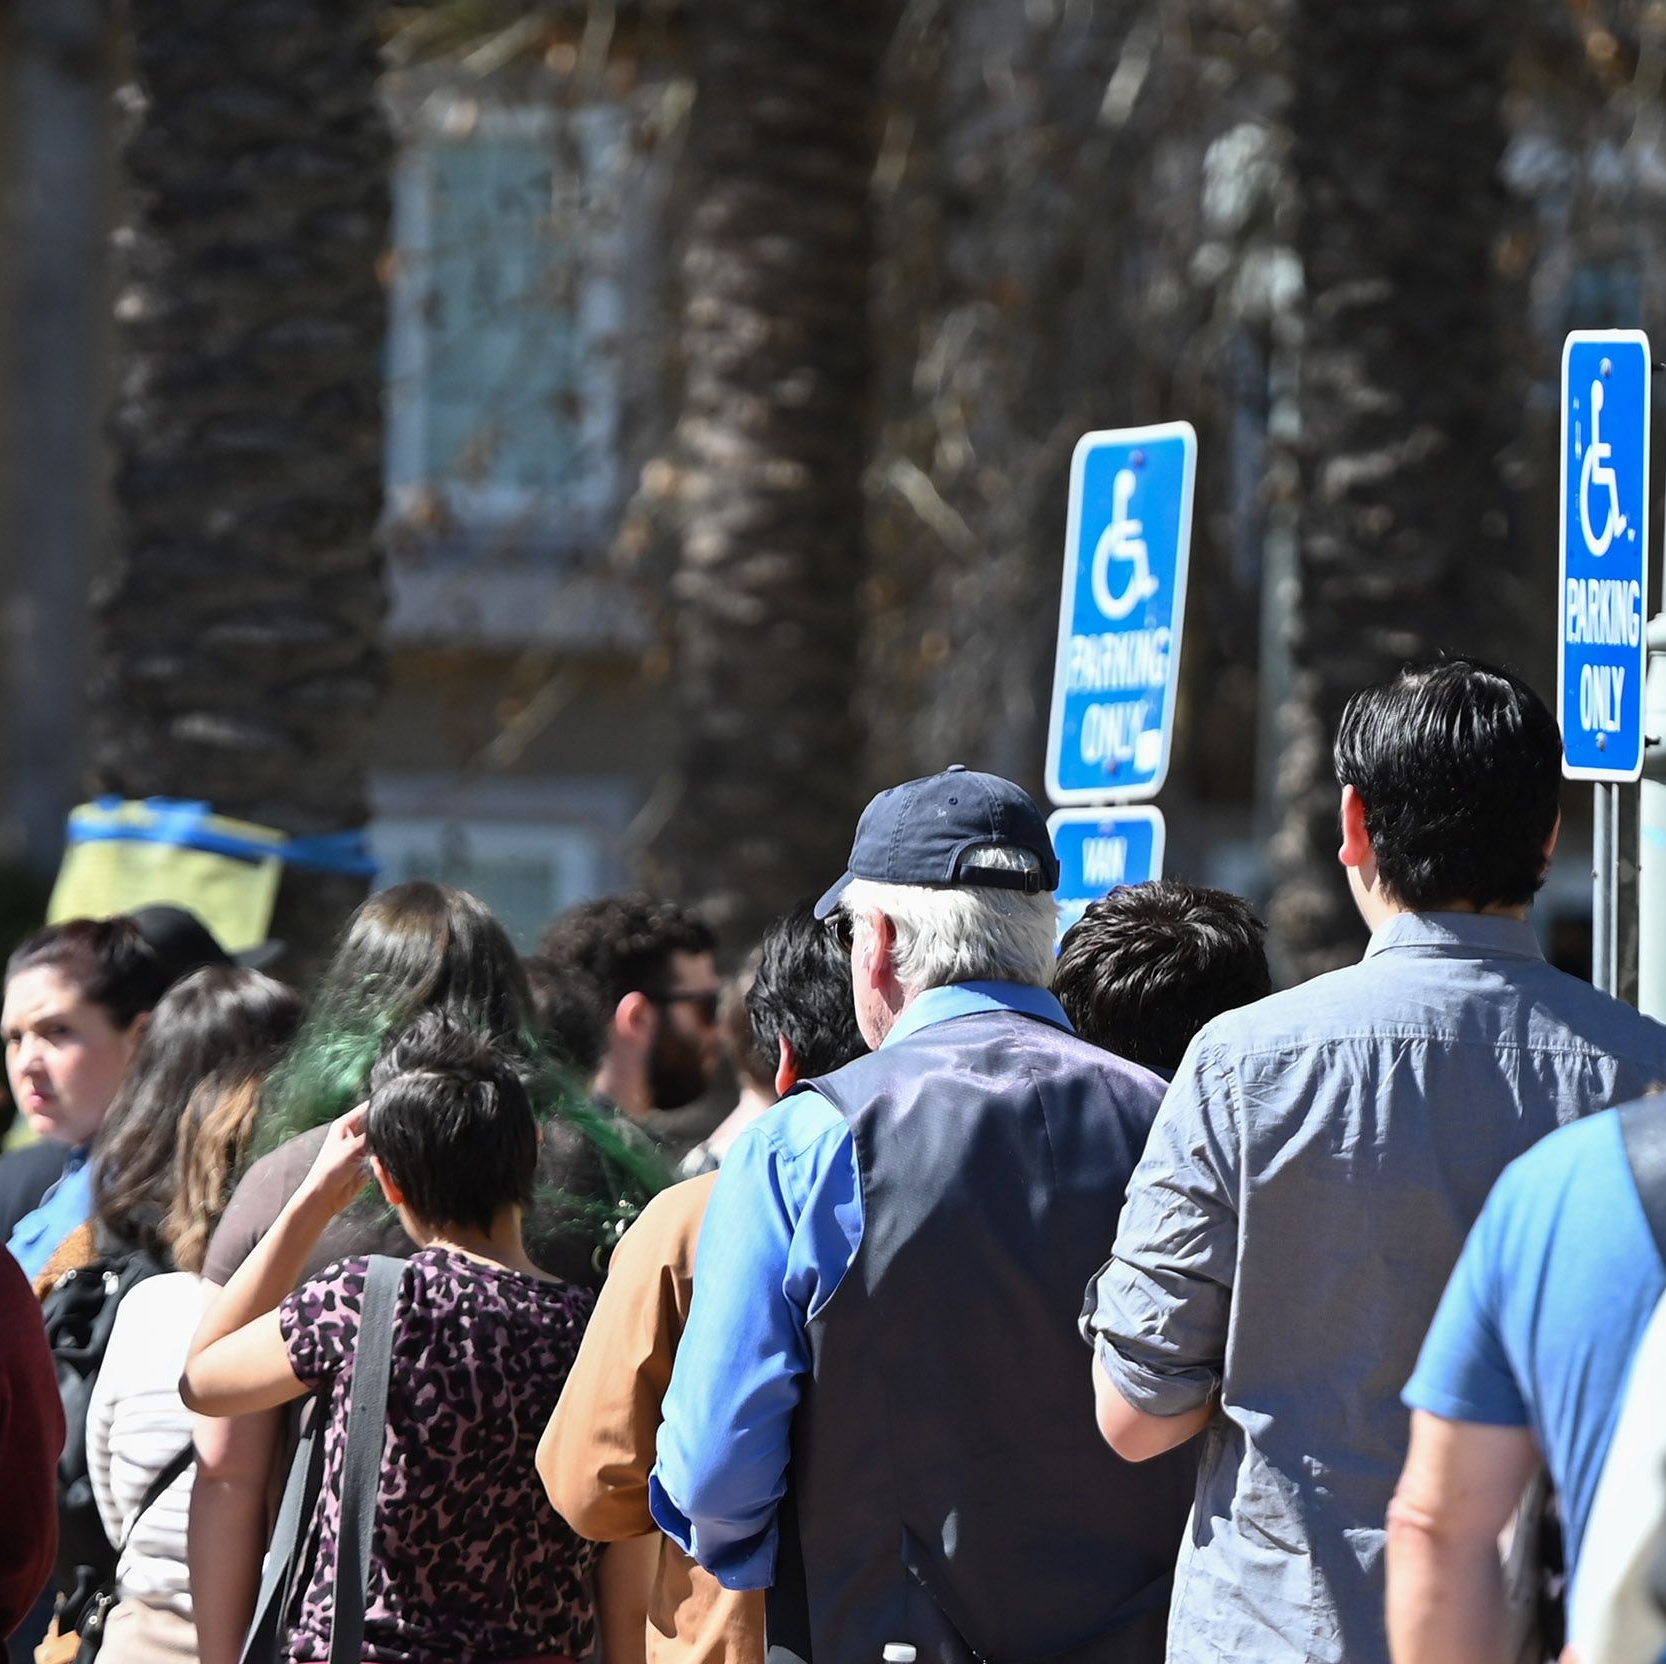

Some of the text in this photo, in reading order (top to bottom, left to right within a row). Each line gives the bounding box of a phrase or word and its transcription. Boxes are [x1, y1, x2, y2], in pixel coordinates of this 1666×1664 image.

[1566, 578, 1640, 648] PARKING
[1068, 627, 1170, 694] PARKING
[1580, 664, 1625, 732] ONLY
[1080, 700, 1149, 765] ONLY
